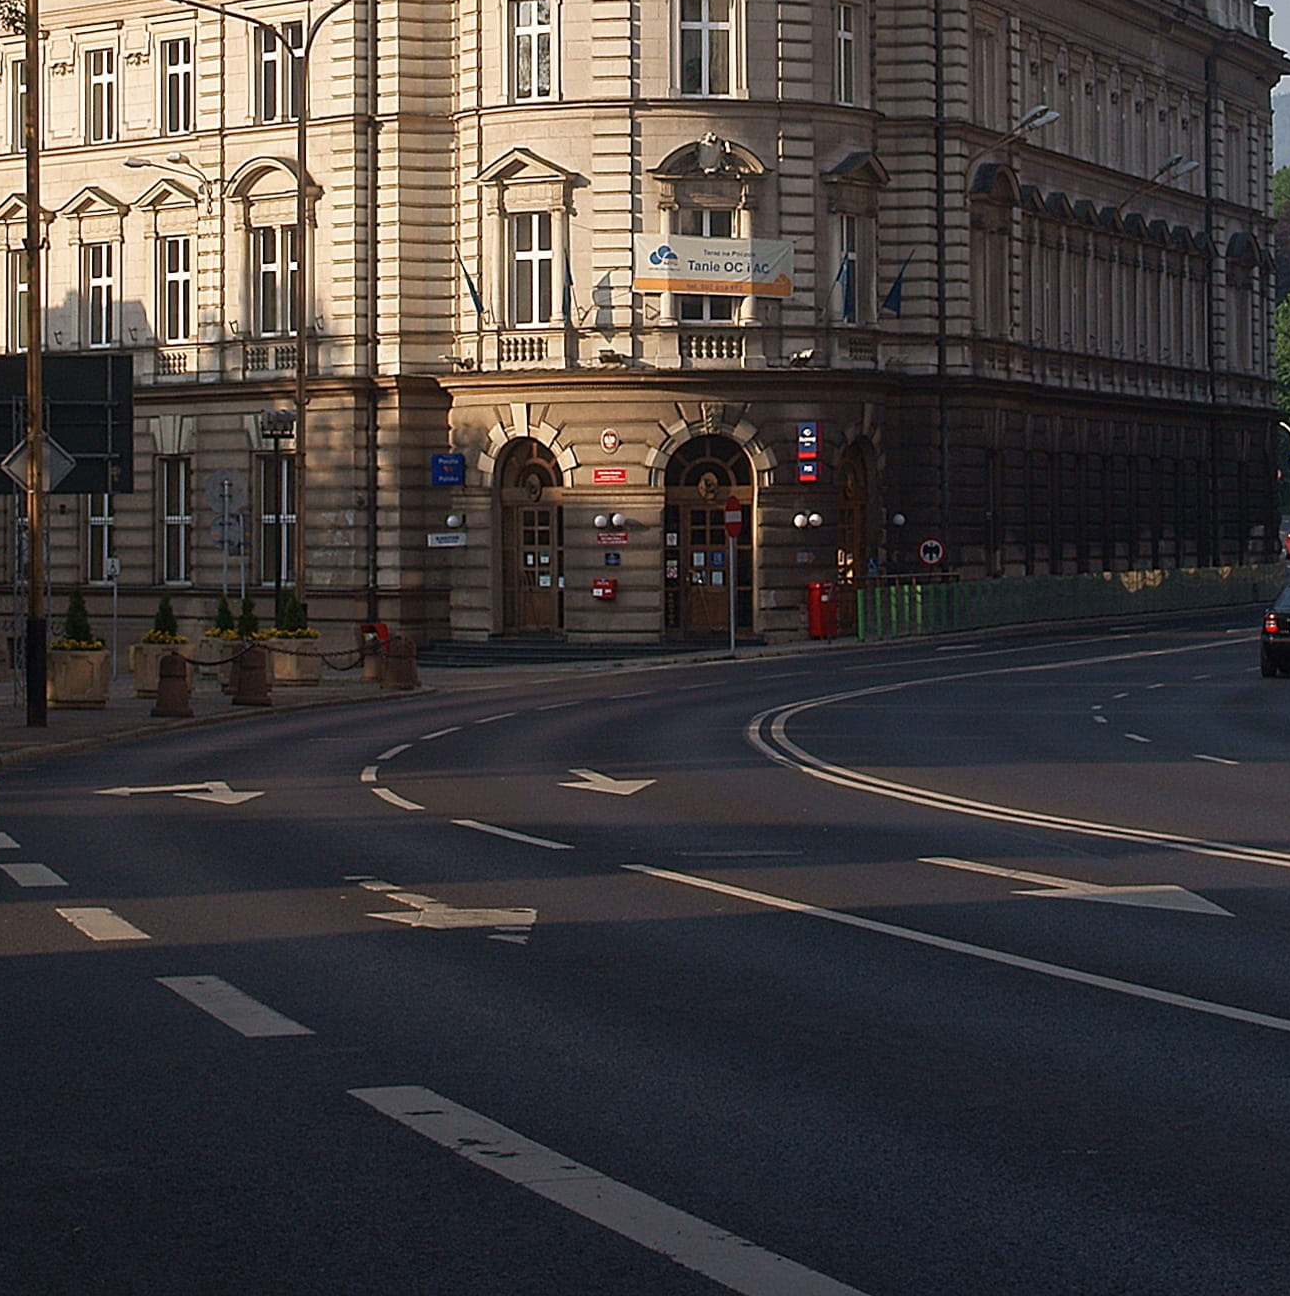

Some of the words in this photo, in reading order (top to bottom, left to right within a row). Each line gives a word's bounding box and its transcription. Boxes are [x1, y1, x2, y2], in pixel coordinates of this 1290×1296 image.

[687, 260, 720, 272] Tanie
[724, 261, 743, 273] OC
[747, 262, 750, 273] i
[753, 263, 770, 274] AC
